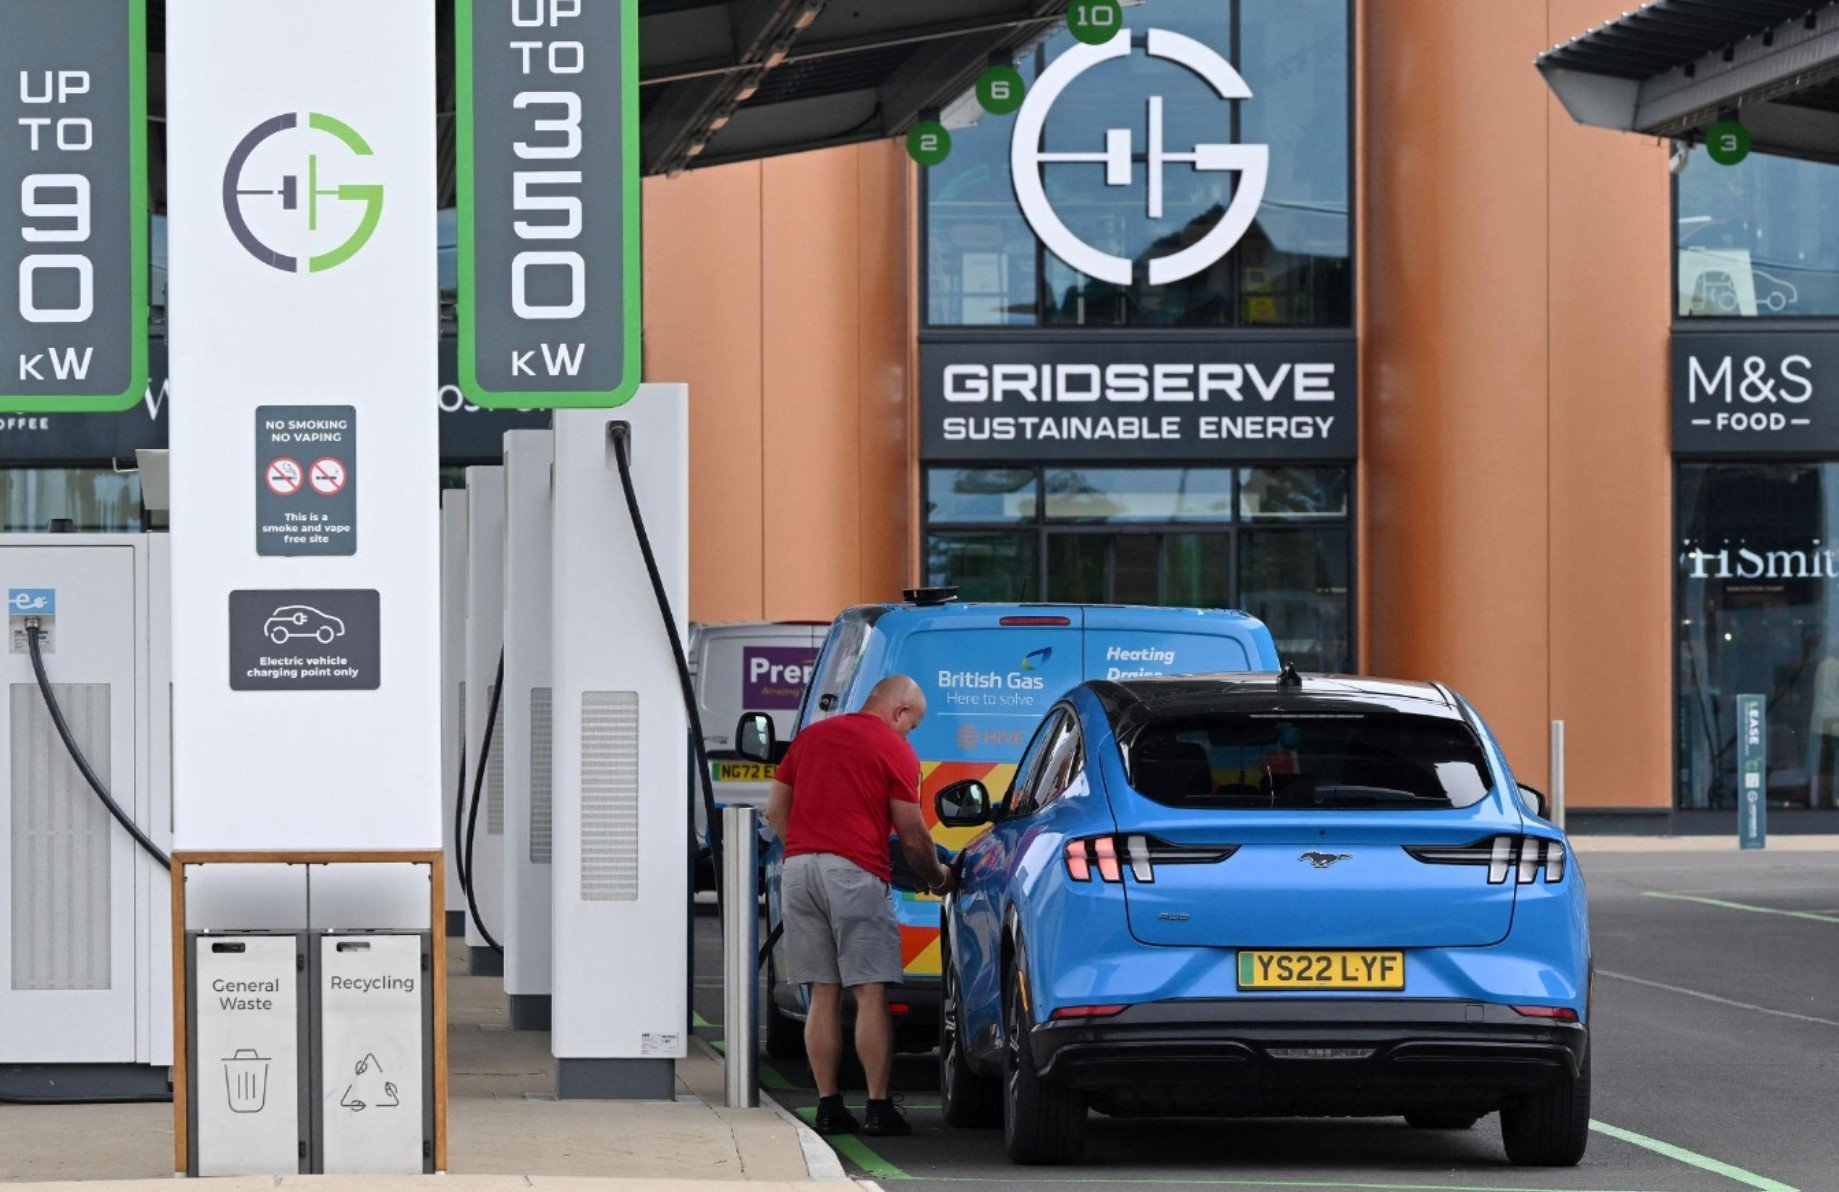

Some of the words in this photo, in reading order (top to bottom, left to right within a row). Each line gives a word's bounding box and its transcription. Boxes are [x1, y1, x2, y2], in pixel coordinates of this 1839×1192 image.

[511, 0, 582, 27] UP
[1077, 5, 1114, 26] 10
[509, 40, 584, 74] TO
[20, 70, 90, 104] UP
[991, 80, 1010, 100] 6
[18, 117, 93, 151] TO
[920, 134, 938, 152] 2
[1720, 134, 1737, 152] 3
[943, 363, 1336, 403] GRIDSERVE
[1688, 354, 1813, 404] M&S
[265, 420, 285, 430] NO
[288, 420, 348, 430] SMOKING
[942, 416, 1181, 440] SUSTAINABLE
[1199, 416, 1335, 440] ENERGY
[1716, 412, 1786, 431] FOOD
[271, 433, 291, 442] NO
[294, 433, 342, 442] VAPING
[284, 513, 307, 521] This
[309, 512, 319, 521] is
[262, 524, 298, 533] smoke
[301, 523, 321, 533] and
[324, 525, 351, 534] vape
[283, 535, 306, 543] free
[309, 534, 329, 543] site
[259, 656, 304, 666] Electric
[306, 655, 347, 665] vehicle
[1106, 647, 1176, 664] Heating
[247, 667, 298, 679] charging
[300, 667, 331, 679] point
[333, 667, 359, 678] only
[937, 670, 1002, 688] British
[1007, 671, 1044, 690] Gas
[946, 692, 979, 705] Here
[983, 693, 996, 705] to
[1000, 692, 1035, 706] solve
[721, 765, 760, 779] NG72
[763, 765, 776, 779] E
[1257, 954, 1333, 982] YS22
[1340, 954, 1398, 982] LYF
[212, 978, 280, 993] General
[330, 975, 415, 993] Recycling
[218, 996, 273, 1010] Waste
